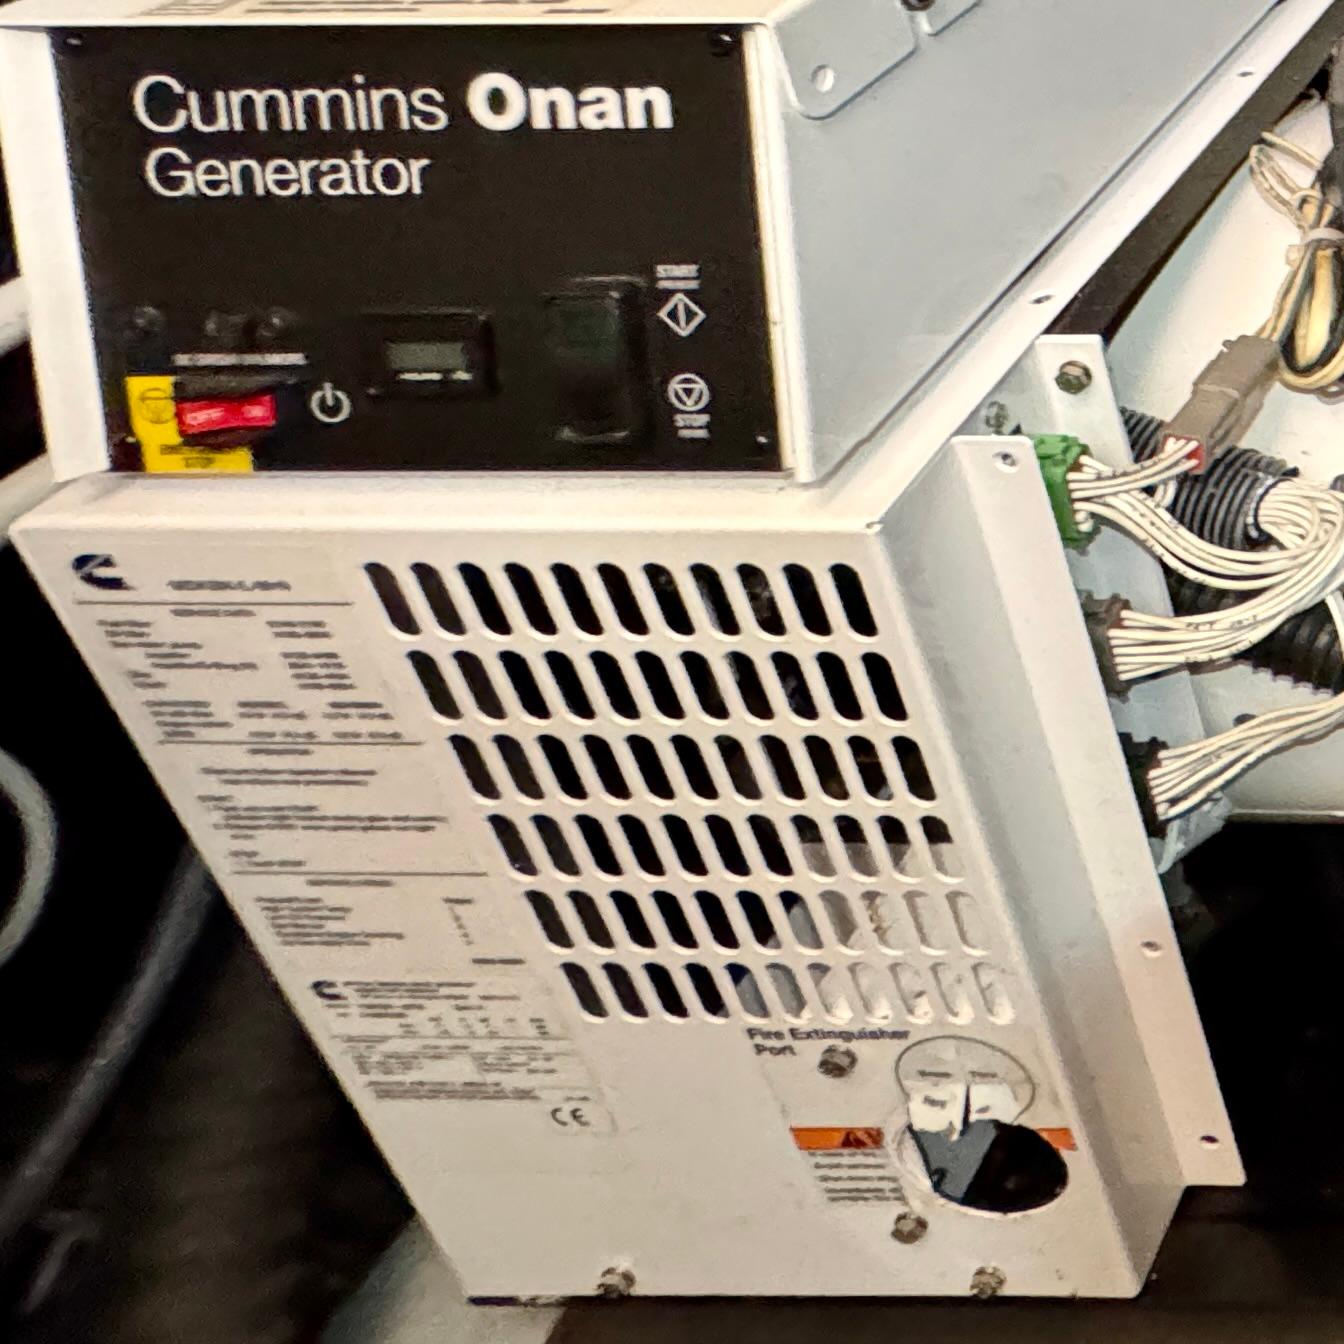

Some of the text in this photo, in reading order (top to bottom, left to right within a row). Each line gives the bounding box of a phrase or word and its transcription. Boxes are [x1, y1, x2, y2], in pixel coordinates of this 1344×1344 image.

[131, 71, 675, 135] Cummins Onan
[144, 146, 432, 199] Generator
[745, 1026, 912, 1043] Fire Extinguisher
[752, 1043, 797, 1057] Port
